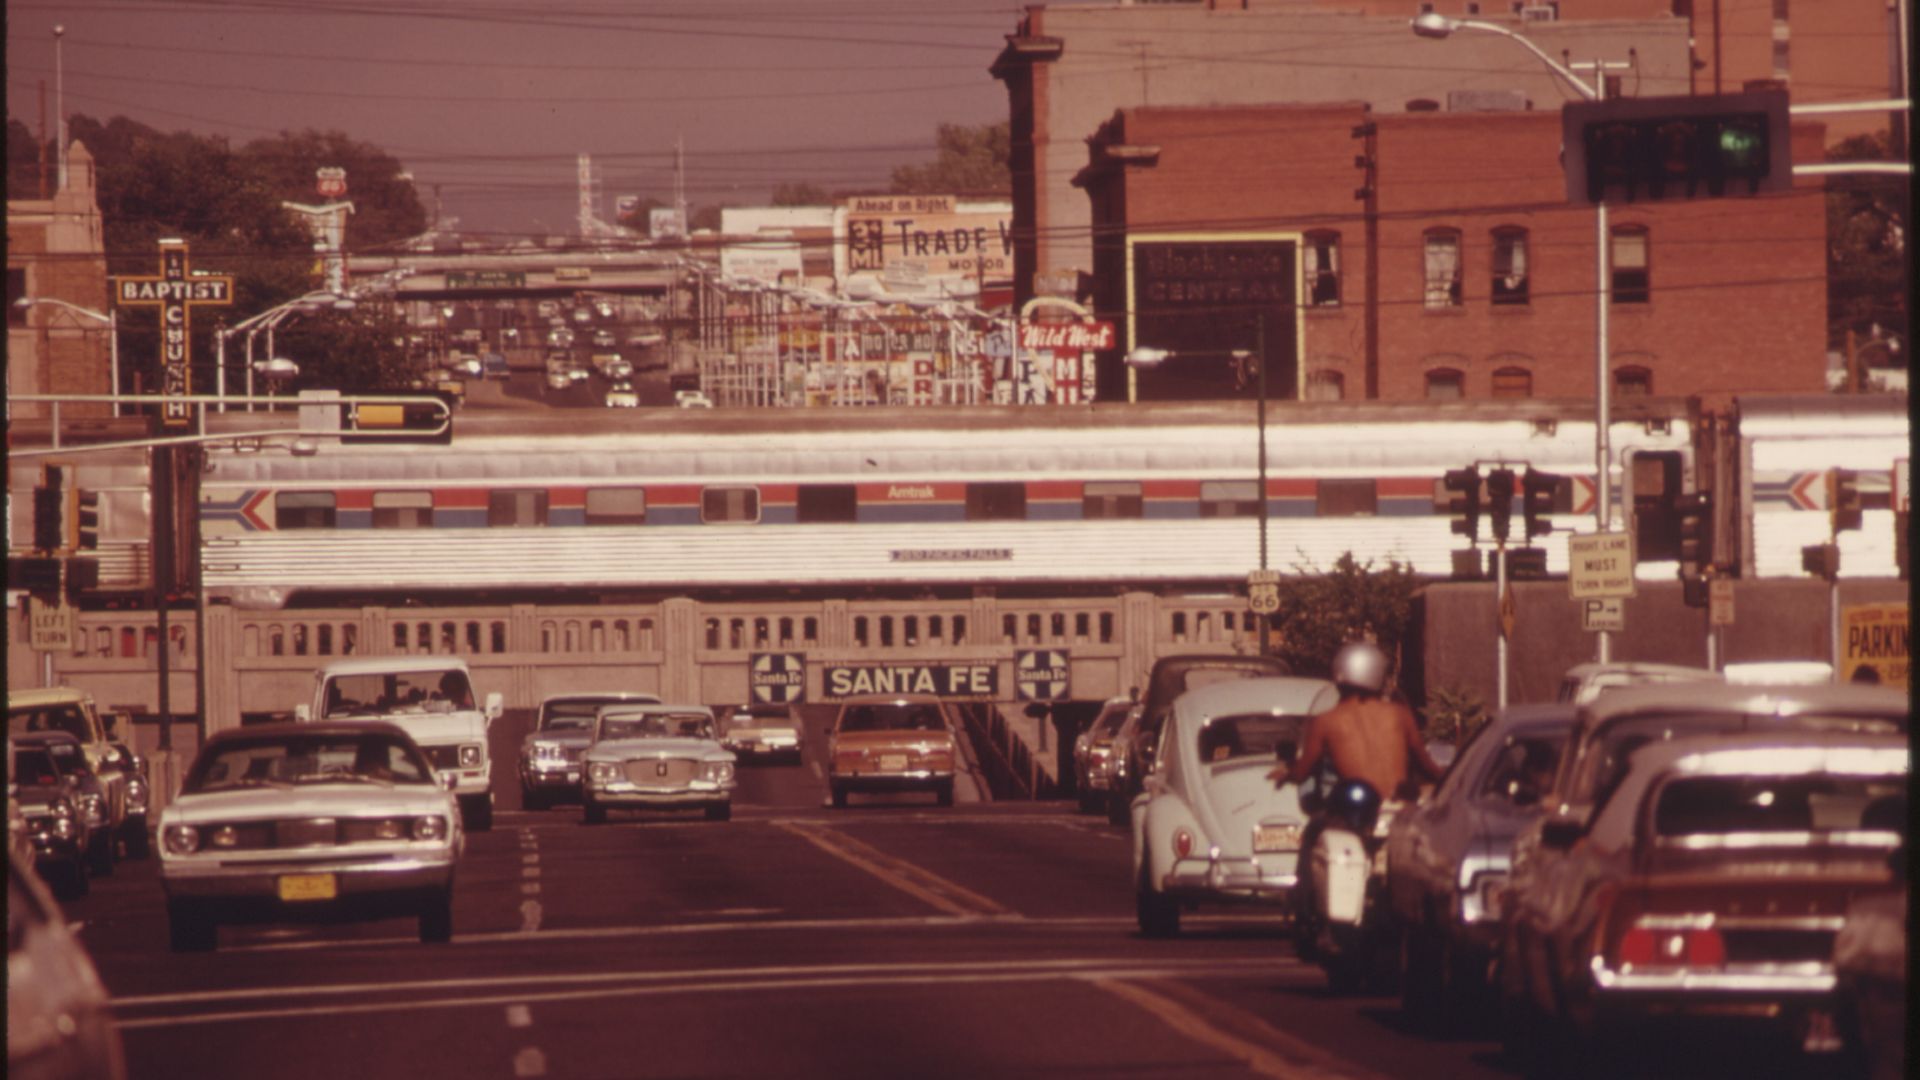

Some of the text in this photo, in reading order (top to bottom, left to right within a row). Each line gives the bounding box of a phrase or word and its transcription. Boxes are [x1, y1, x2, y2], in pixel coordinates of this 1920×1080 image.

[856, 200, 893, 211] Ahead
[917, 199, 948, 213] Right
[893, 219, 986, 256] TRADE
[123, 281, 225, 299] BAPTIST
[1021, 324, 1066, 347] Wild
[1067, 324, 1110, 347] West
[888, 485, 934, 498] Amtrak
[1573, 540, 1626, 551] RIGHT LANE
[1585, 559, 1616, 571] MUST
[1576, 578, 1629, 589] TURN RIGHT
[1252, 594, 1277, 608] 66
[36, 615, 65, 627] LEFT
[36, 631, 67, 643] TURN
[753, 671, 801, 684] Santa Fe
[831, 667, 990, 694] SANTA FE
[1018, 669, 1067, 681] Santa Fe
